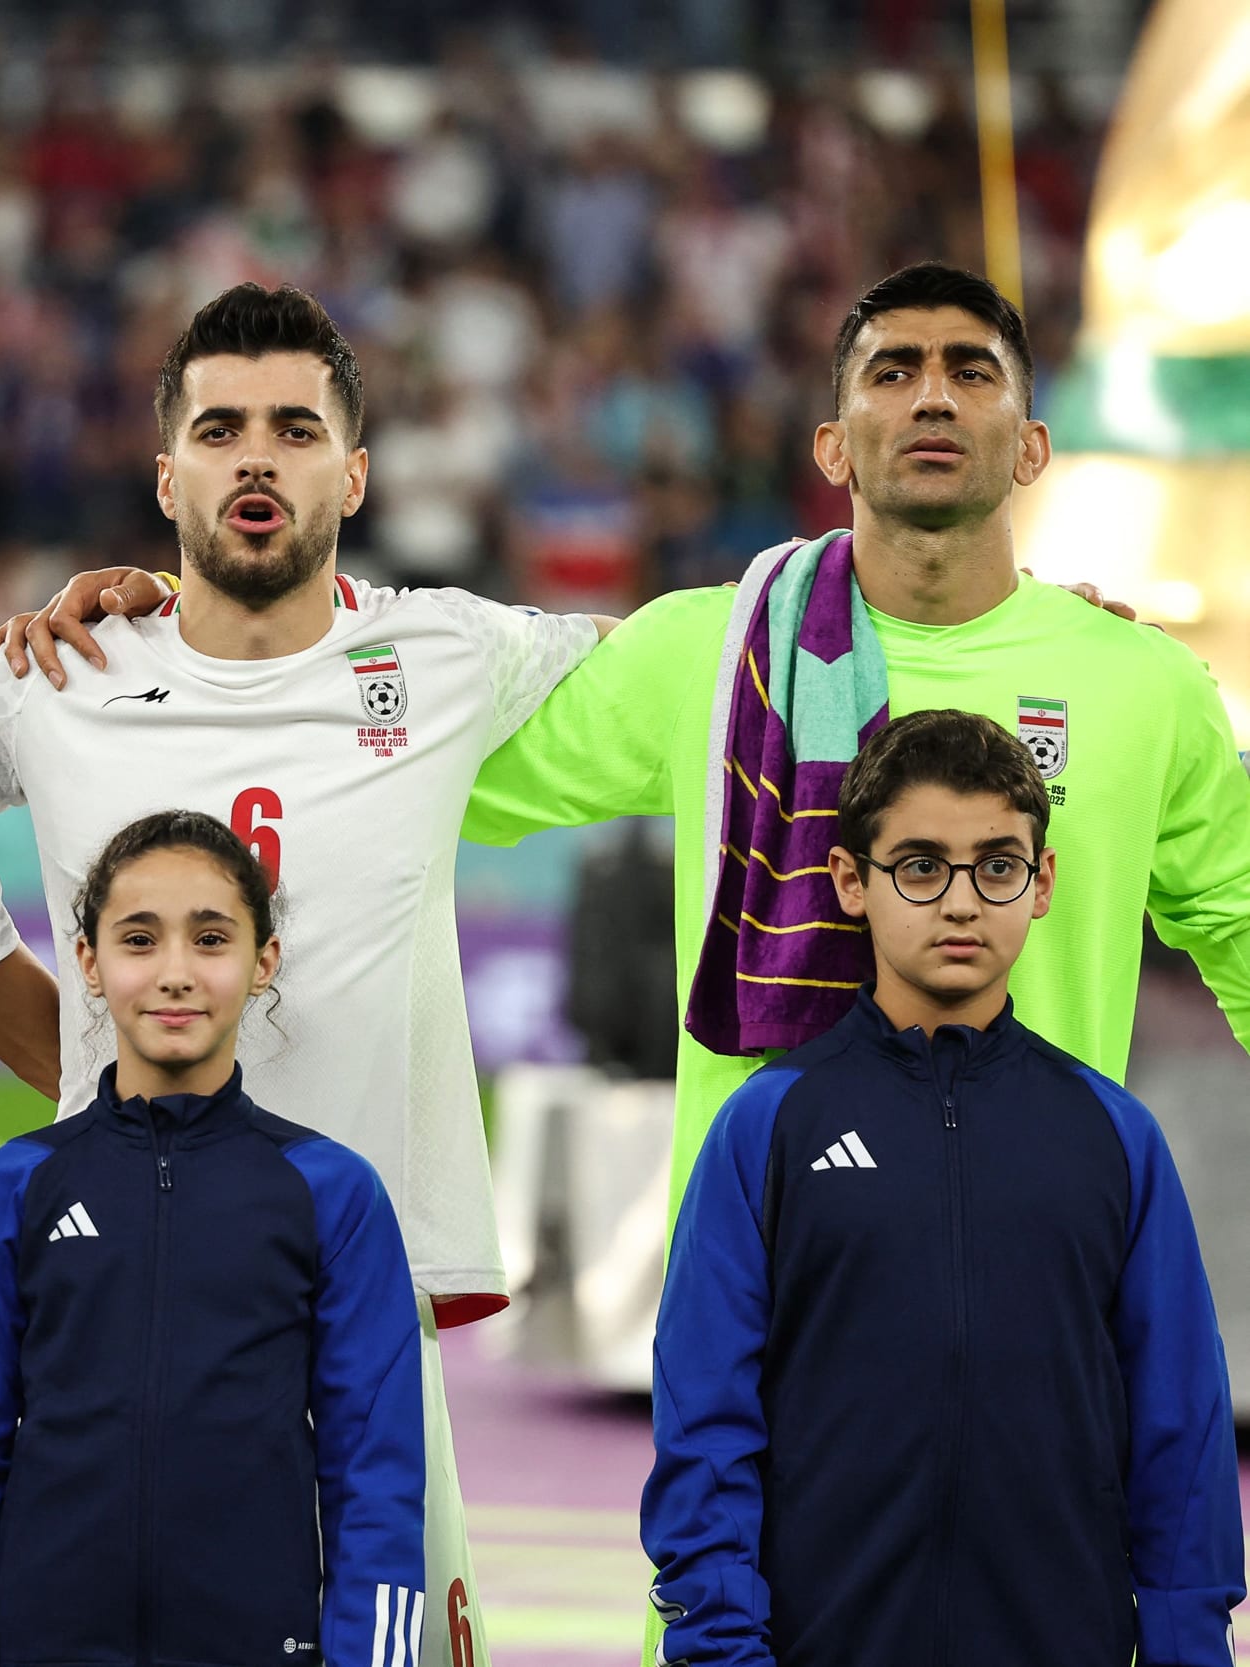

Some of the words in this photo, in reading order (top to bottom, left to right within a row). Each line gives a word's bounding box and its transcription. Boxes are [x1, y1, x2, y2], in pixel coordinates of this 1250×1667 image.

[357, 728, 366, 737] IR
[358, 738, 368, 747] 29
[369, 738, 386, 747] NOV
[388, 737, 408, 747] 2022
[230, 786, 283, 898] 6
[447, 1577, 474, 1667] 6
